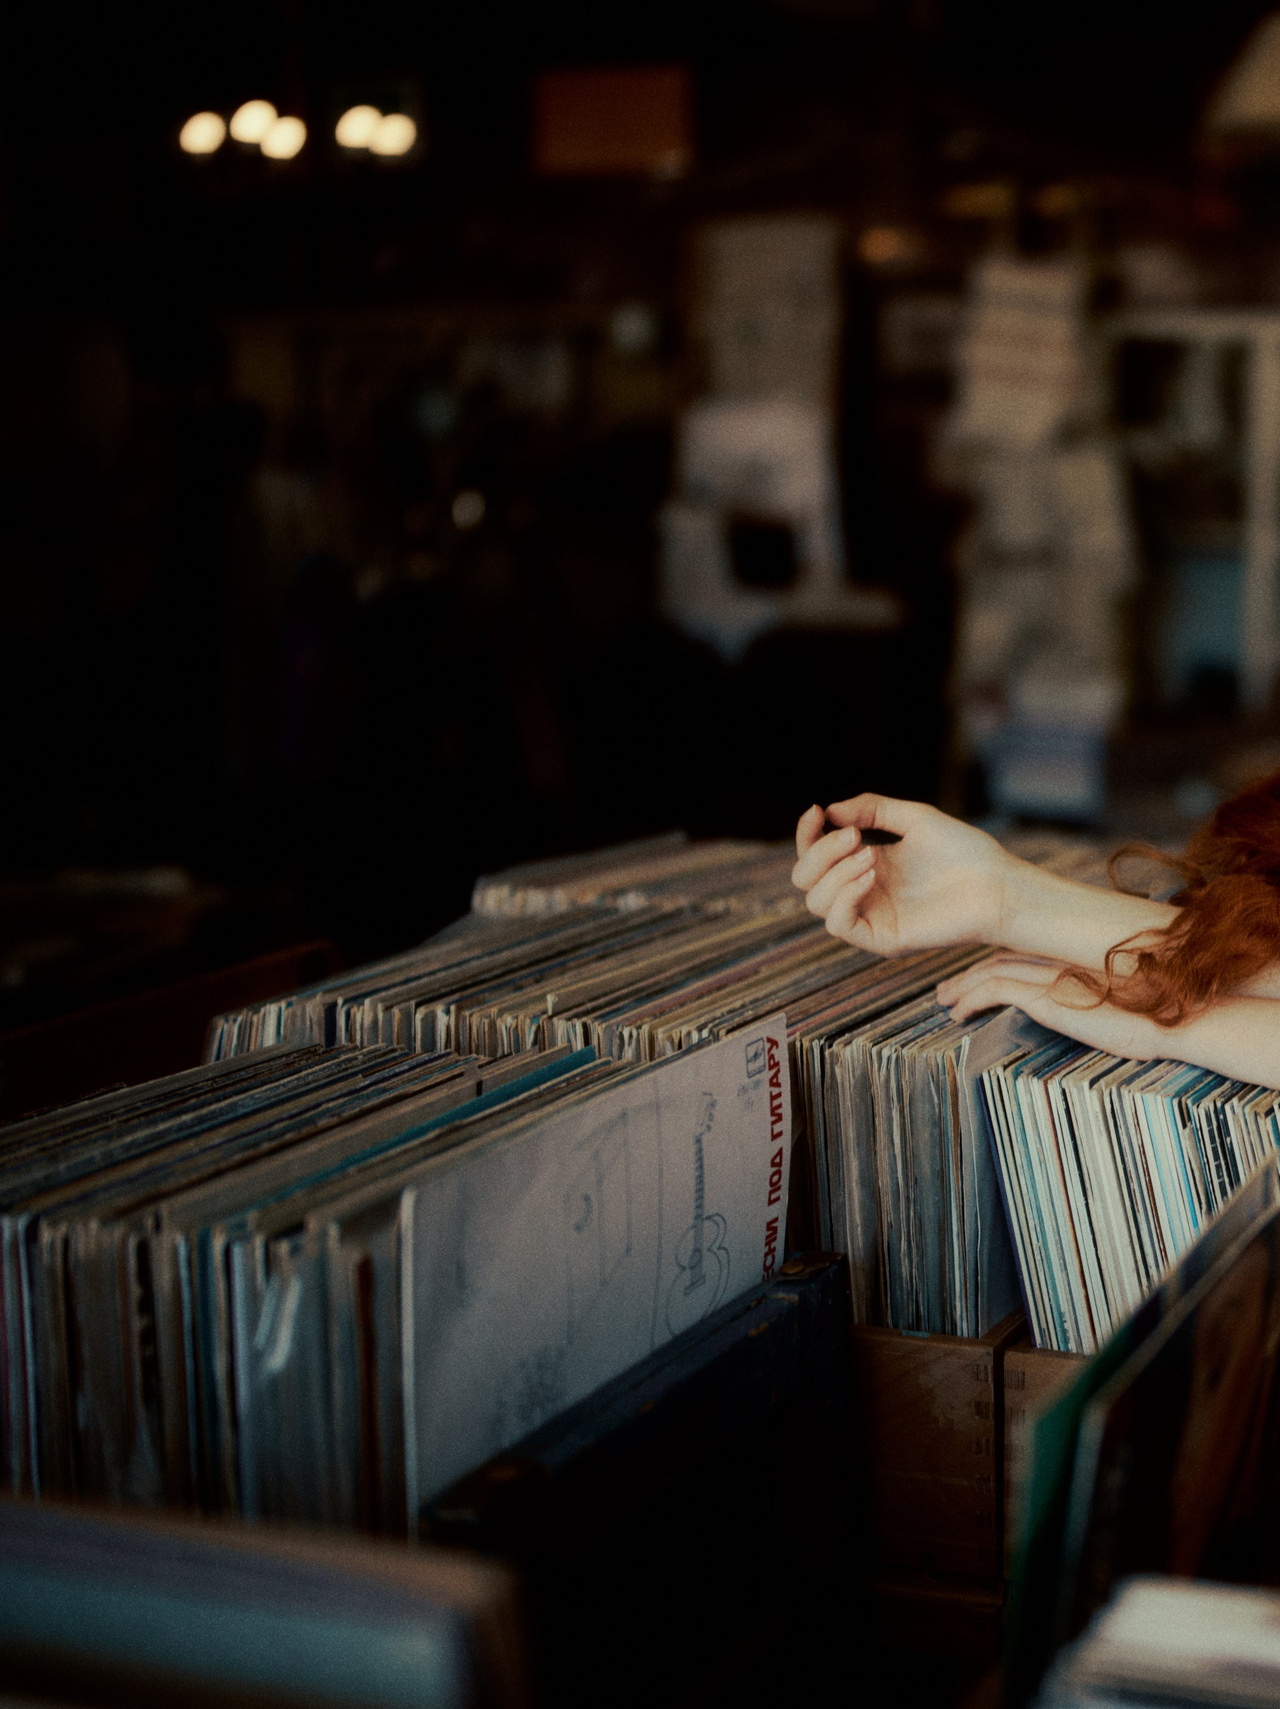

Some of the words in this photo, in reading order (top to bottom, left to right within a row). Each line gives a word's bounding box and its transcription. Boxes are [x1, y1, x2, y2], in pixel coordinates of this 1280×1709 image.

[766, 1036, 783, 1142] ГИТАРУ
[767, 1147, 783, 1207] ПОД
[761, 1216, 779, 1281] ЕСНИ
